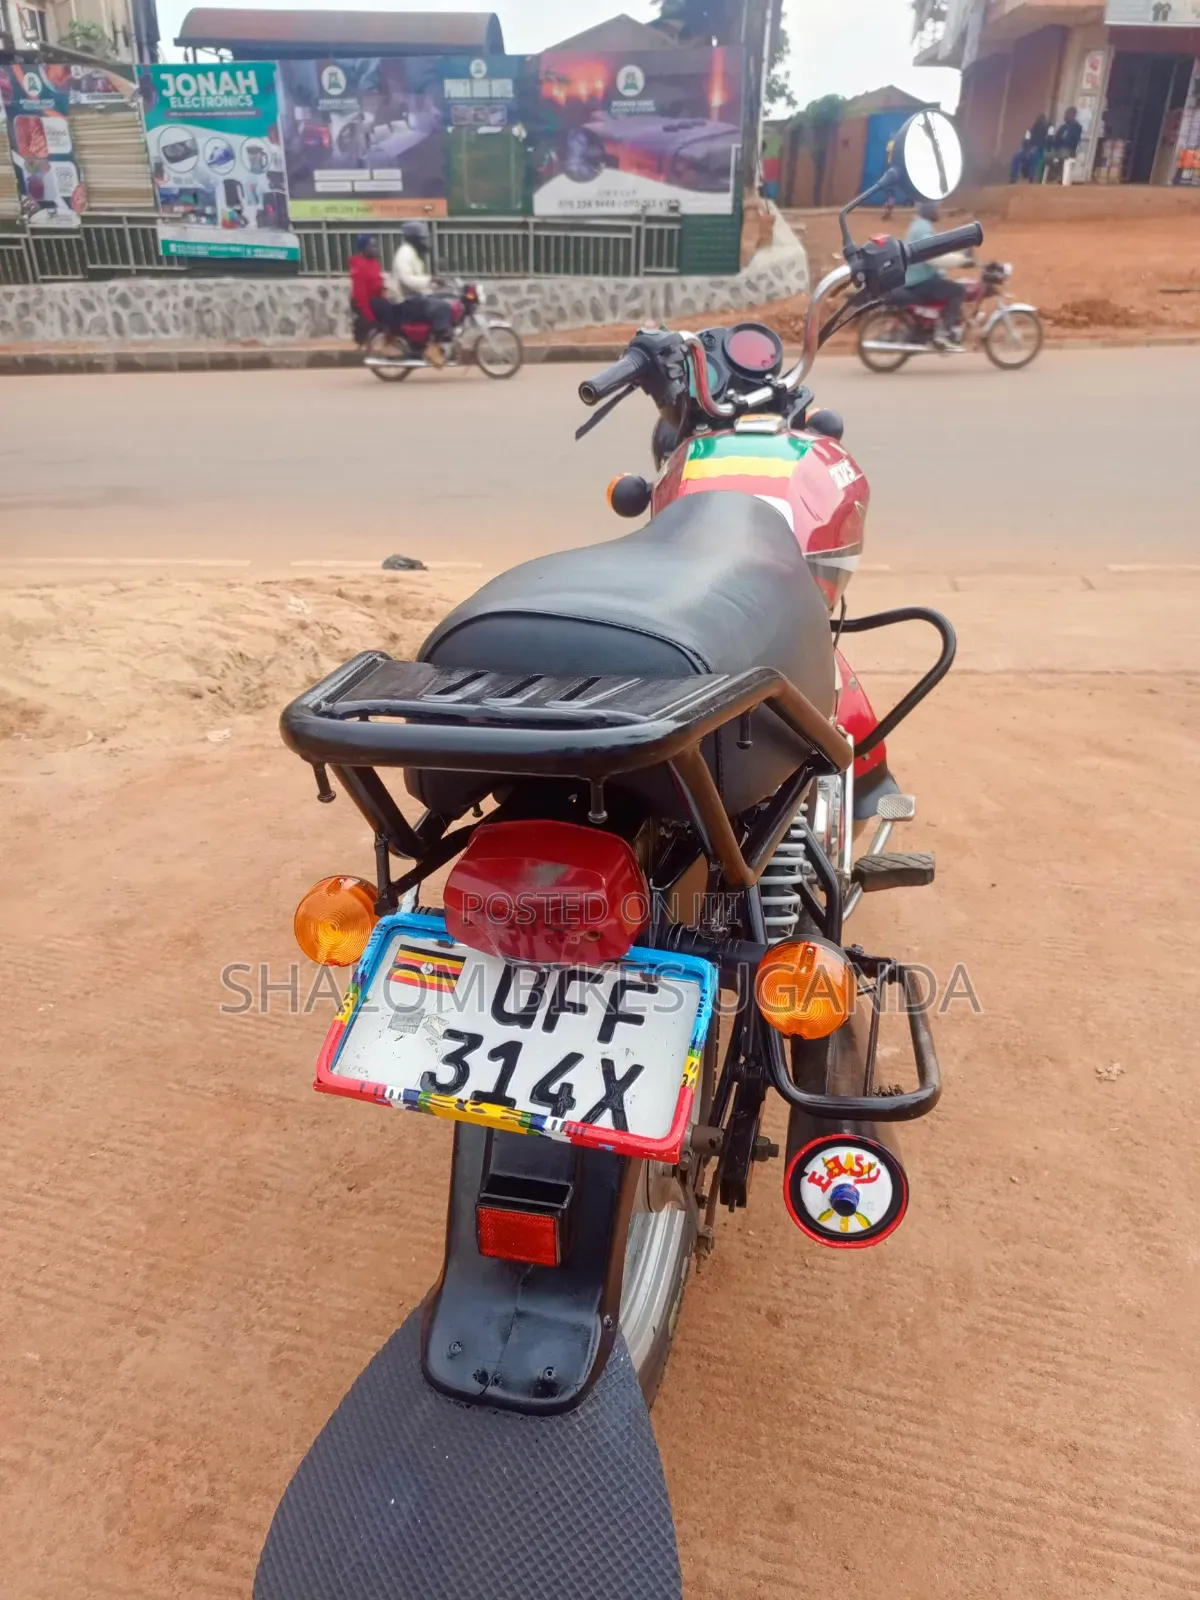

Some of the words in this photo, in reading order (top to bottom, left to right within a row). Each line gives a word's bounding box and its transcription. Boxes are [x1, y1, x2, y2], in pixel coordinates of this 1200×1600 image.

[160, 69, 259, 98] JONAH
[169, 94, 254, 109] ELECTRONICS
[490, 962, 659, 1044] UFF
[419, 1028, 645, 1133] 314X
